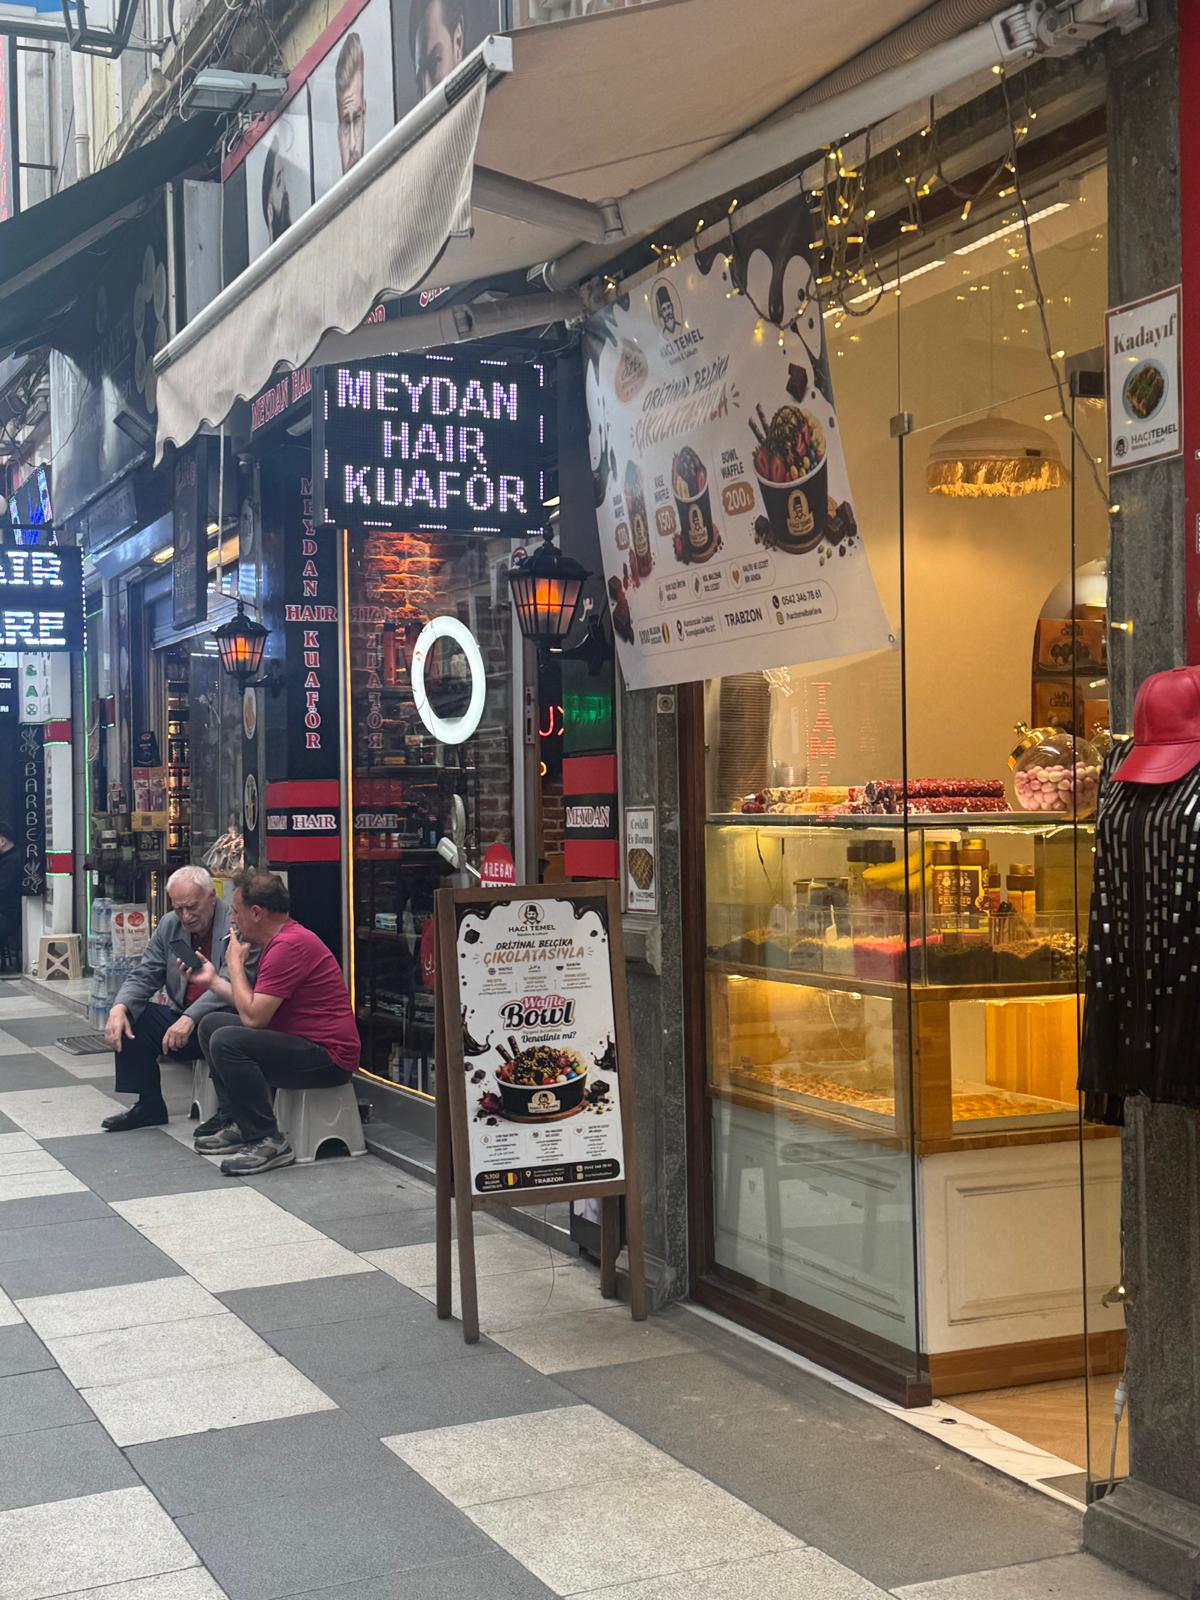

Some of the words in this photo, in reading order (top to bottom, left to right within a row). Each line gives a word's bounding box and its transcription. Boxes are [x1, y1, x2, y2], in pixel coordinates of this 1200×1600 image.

[674, 328, 704, 351] TEMEL
[1113, 313, 1176, 355] Kadayıf
[337, 368, 518, 421] MEYDAN
[383, 421, 487, 464] HAIR
[721, 449, 739, 464] BOWL
[721, 462, 745, 480] WAFFLE
[344, 464, 528, 514] KUAFÖR
[285, 604, 338, 623] HAIR
[725, 607, 763, 627] TRABZON
[303, 630, 321, 749] KUAFÖR
[24, 762, 38, 858] BARBER
[565, 805, 611, 828] MEYDAN
[292, 814, 338, 830] HAIR
[530, 924, 556, 932] TEMEL
[495, 940, 536, 951] ORİJİNAL
[538, 938, 573, 949] BELÇİKA
[522, 995, 566, 1009] Waffle
[500, 1000, 574, 1029] Bowl
[534, 1176, 564, 1184] TRABZON
